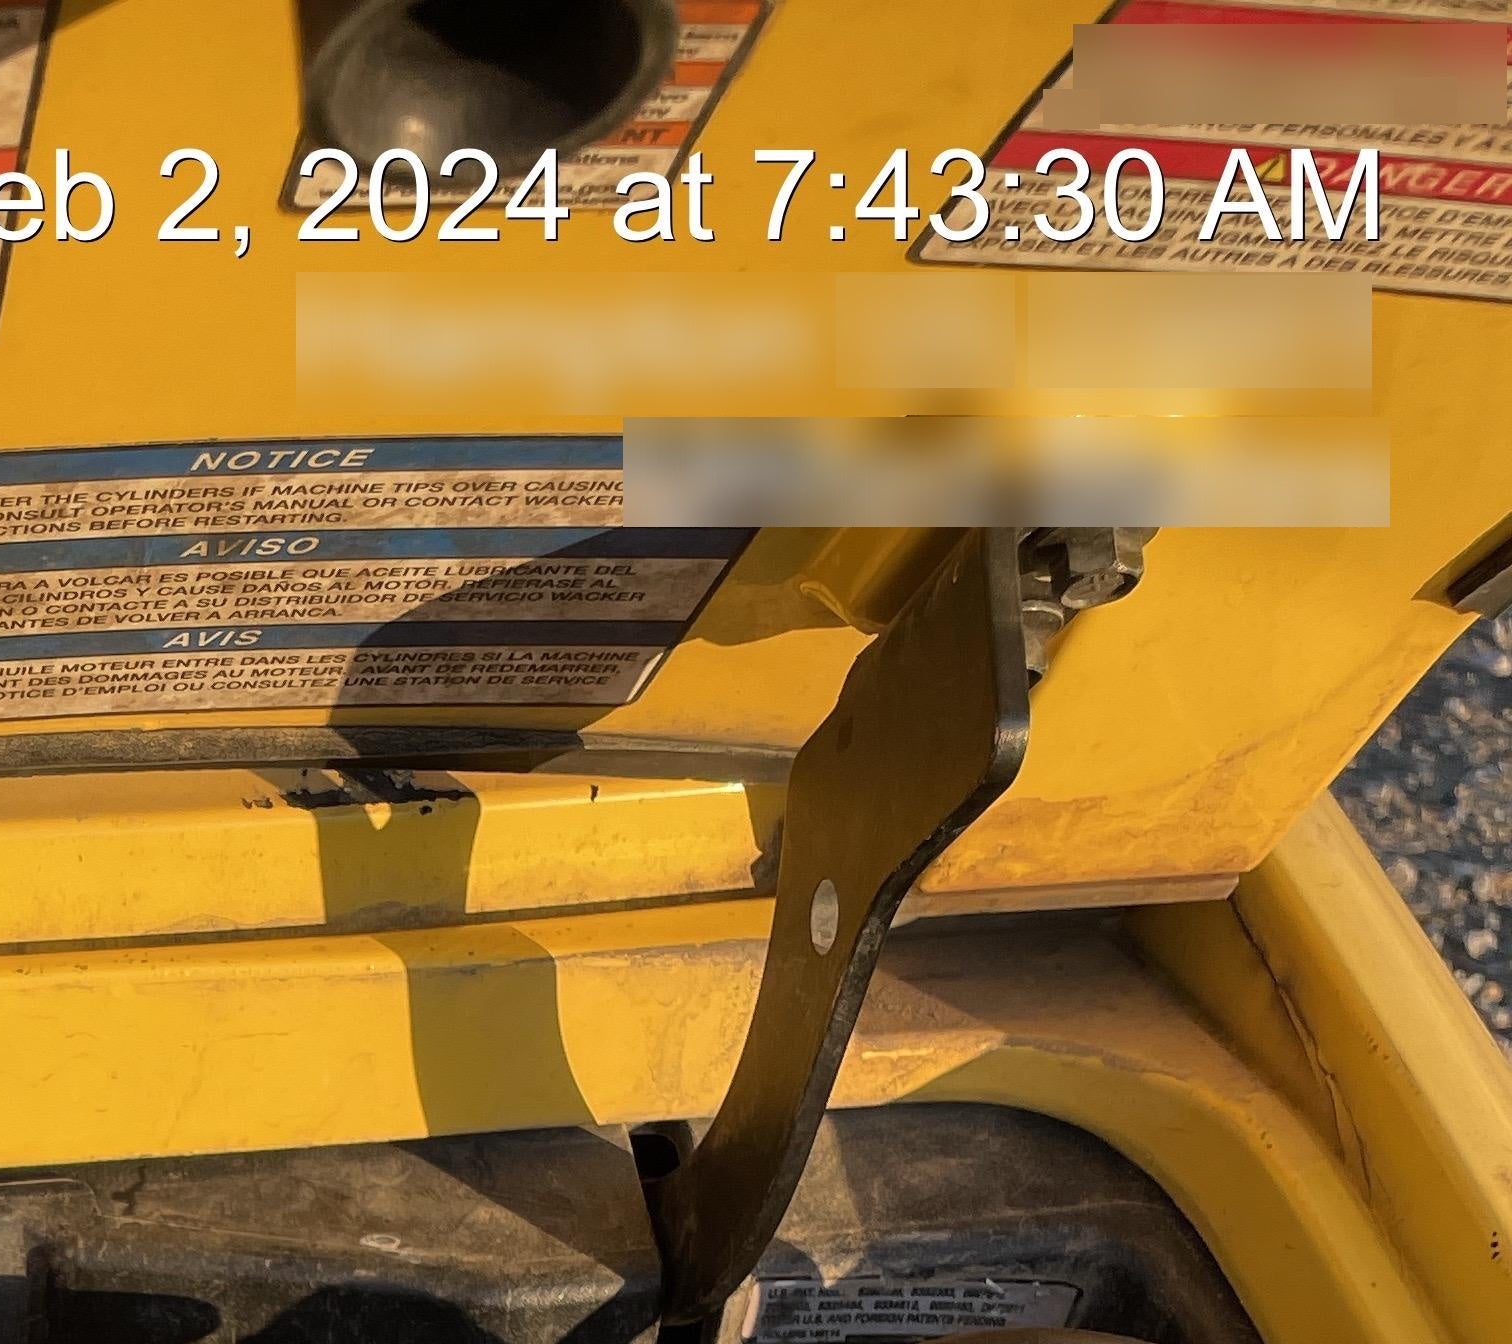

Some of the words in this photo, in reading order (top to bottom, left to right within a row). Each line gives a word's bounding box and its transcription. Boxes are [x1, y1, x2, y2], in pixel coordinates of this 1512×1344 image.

[190, 448, 375, 471] NOTICE
[41, 492, 88, 505] THE
[96, 486, 234, 502] CYLINDERS
[242, 485, 265, 496] IF
[271, 482, 384, 495] MACHINE
[394, 482, 443, 492] TIPS
[452, 482, 516, 491] OVER
[92, 500, 244, 516] OPERATOR'S
[253, 496, 354, 510] MANUAL
[362, 497, 396, 507] OR
[404, 496, 518, 506] CONTACT
[89, 516, 185, 531] BEFORE
[194, 511, 347, 526] RESTARTING.
[180, 537, 320, 557] AVISO
[34, 579, 48, 590] A
[58, 574, 150, 588] VOLCAR
[159, 572, 187, 584] ES
[195, 569, 294, 582] POSIBLE
[302, 569, 345, 579] QUE
[355, 567, 438, 578] ACEITE
[444, 566, 583, 576] LUBRICANTE
[594, 565, 637, 575] DEL
[21, 605, 38, 616] O
[45, 599, 166, 615] CONTACTE
[172, 598, 188, 609] A
[196, 596, 227, 608] SU
[234, 592, 396, 606] DISTRIBUIDOR
[402, 593, 433, 602] DE
[438, 592, 546, 602] SERVICIO
[550, 592, 646, 600] WACKER
[76, 615, 106, 626] DE
[115, 610, 200, 624] VOLVER
[206, 609, 220, 620] A
[230, 607, 342, 619] ARRANCA.
[163, 629, 263, 648] AVIS
[60, 659, 154, 674] MOTEUR
[162, 656, 233, 669] ENTRE
[240, 654, 300, 666] DANS
[307, 654, 346, 664] LES
[354, 652, 476, 663] CYLINDRES
[481, 652, 502, 661] SI
[508, 652, 533, 661] LA
[540, 652, 640, 661] MACHINE
[62, 682, 166, 697] D'EMPLOI
[172, 681, 203, 692] OU
[210, 677, 338, 691] CONSULTEZ
[344, 677, 388, 687] UNE
[393, 676, 480, 686] STATION
[488, 676, 514, 685] DE
[521, 675, 610, 684] SERVICE
